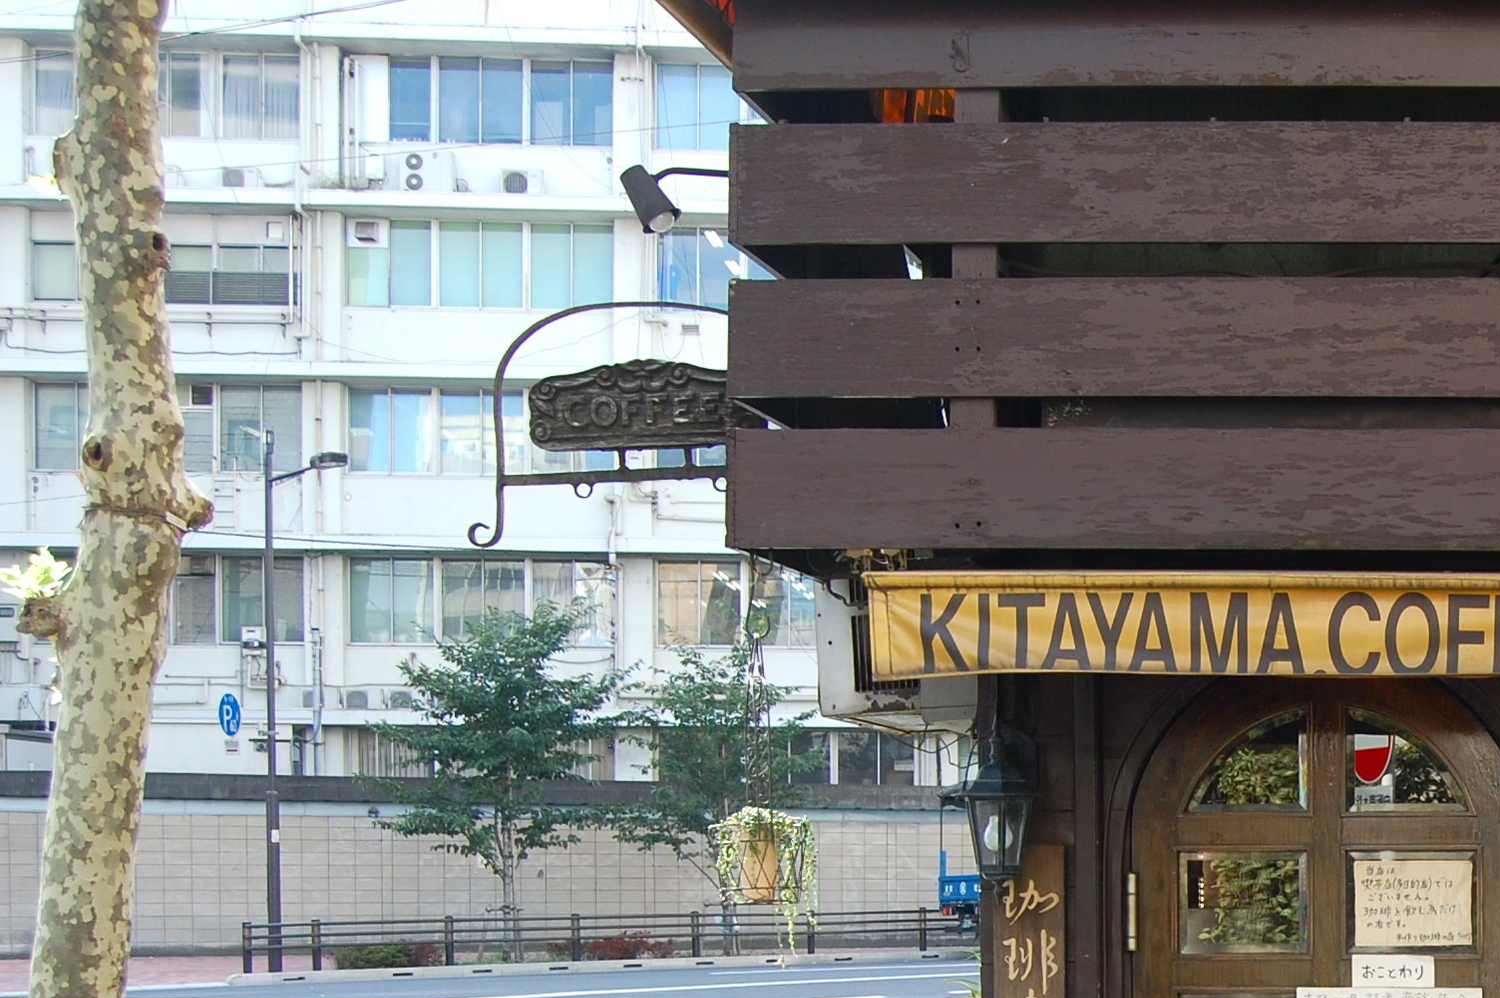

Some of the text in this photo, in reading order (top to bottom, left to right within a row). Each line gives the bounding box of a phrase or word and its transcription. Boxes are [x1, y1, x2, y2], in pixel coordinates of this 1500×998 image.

[564, 391, 722, 428] COFFEE
[1361, 965, 1424, 981] おことわり
